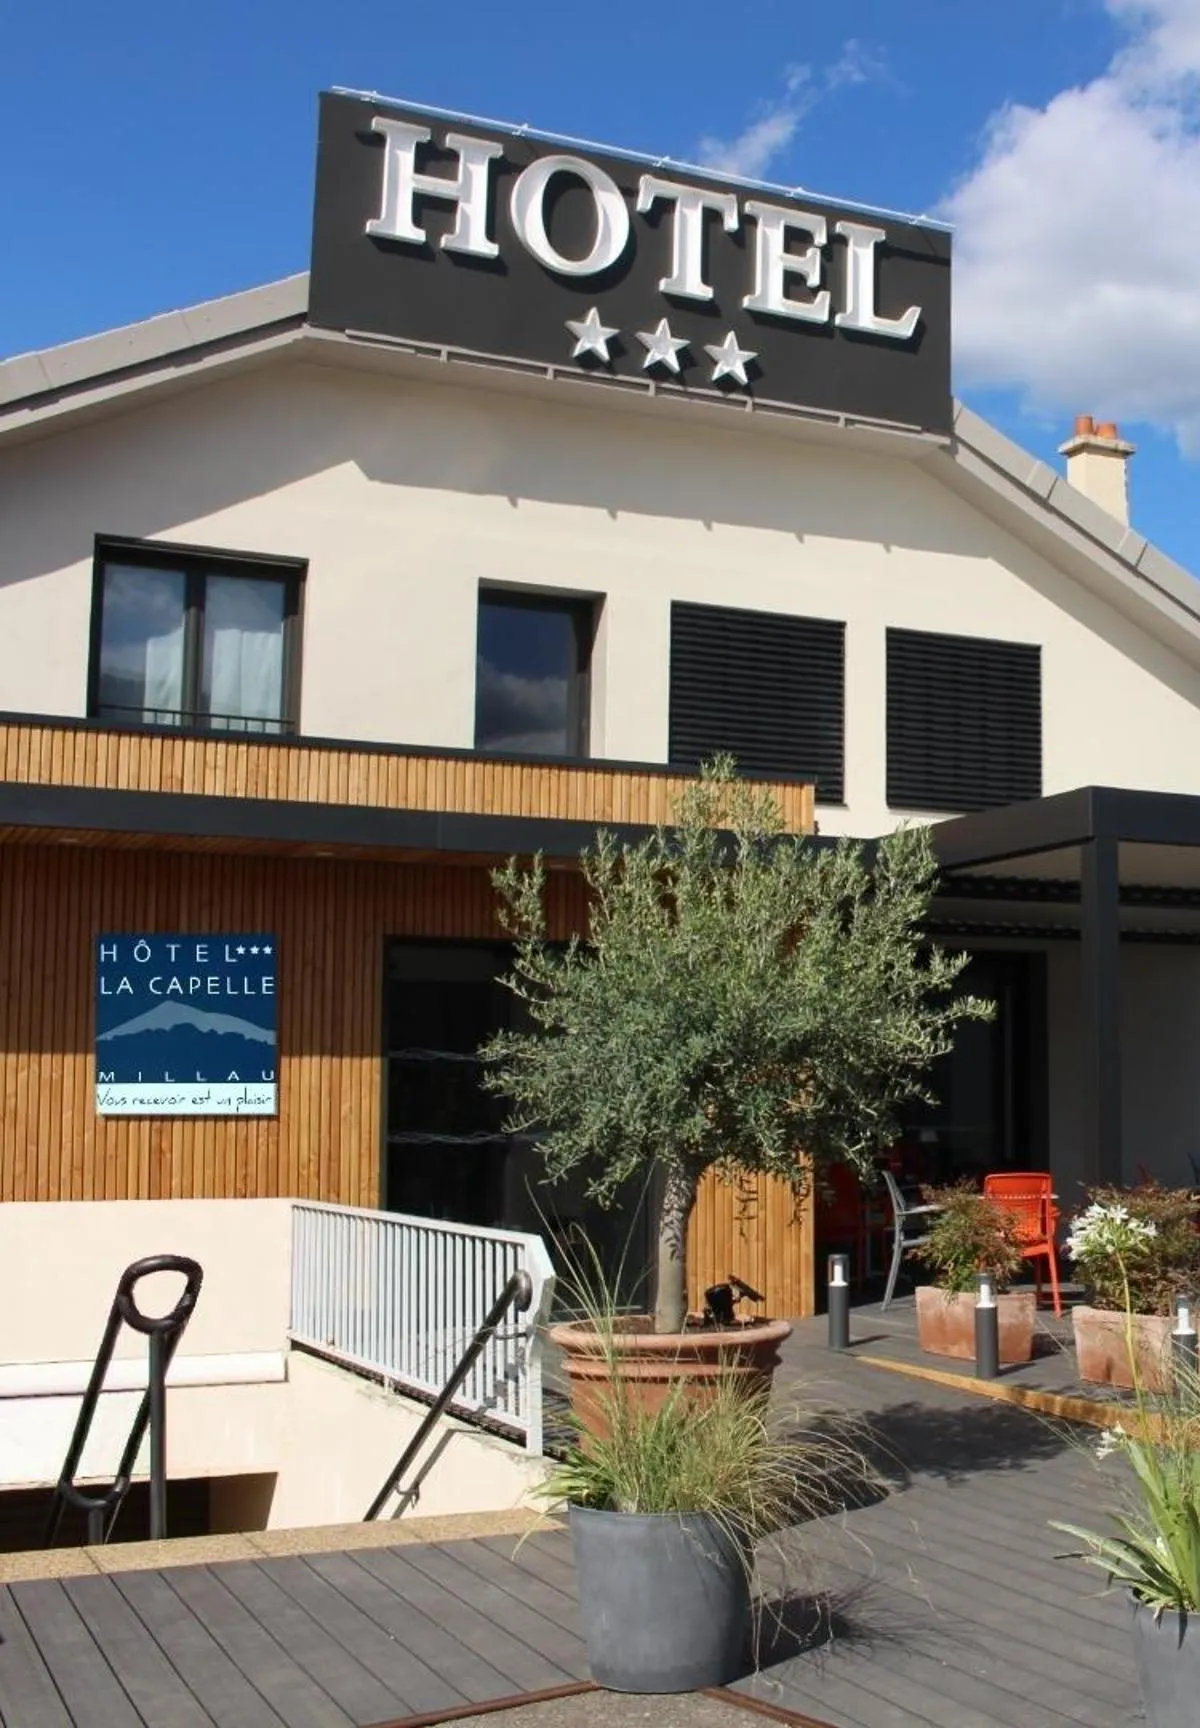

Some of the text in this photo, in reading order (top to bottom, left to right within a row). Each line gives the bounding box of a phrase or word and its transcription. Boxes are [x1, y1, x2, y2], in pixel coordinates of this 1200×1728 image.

[364, 115, 922, 340] HOTEL
[100, 939, 238, 963] HÔTEL
[100, 976, 275, 995] LA CAPELLE
[99, 1070, 275, 1082] MILLAU
[97, 1087, 272, 1112] Vous recevoir est un plaisir
